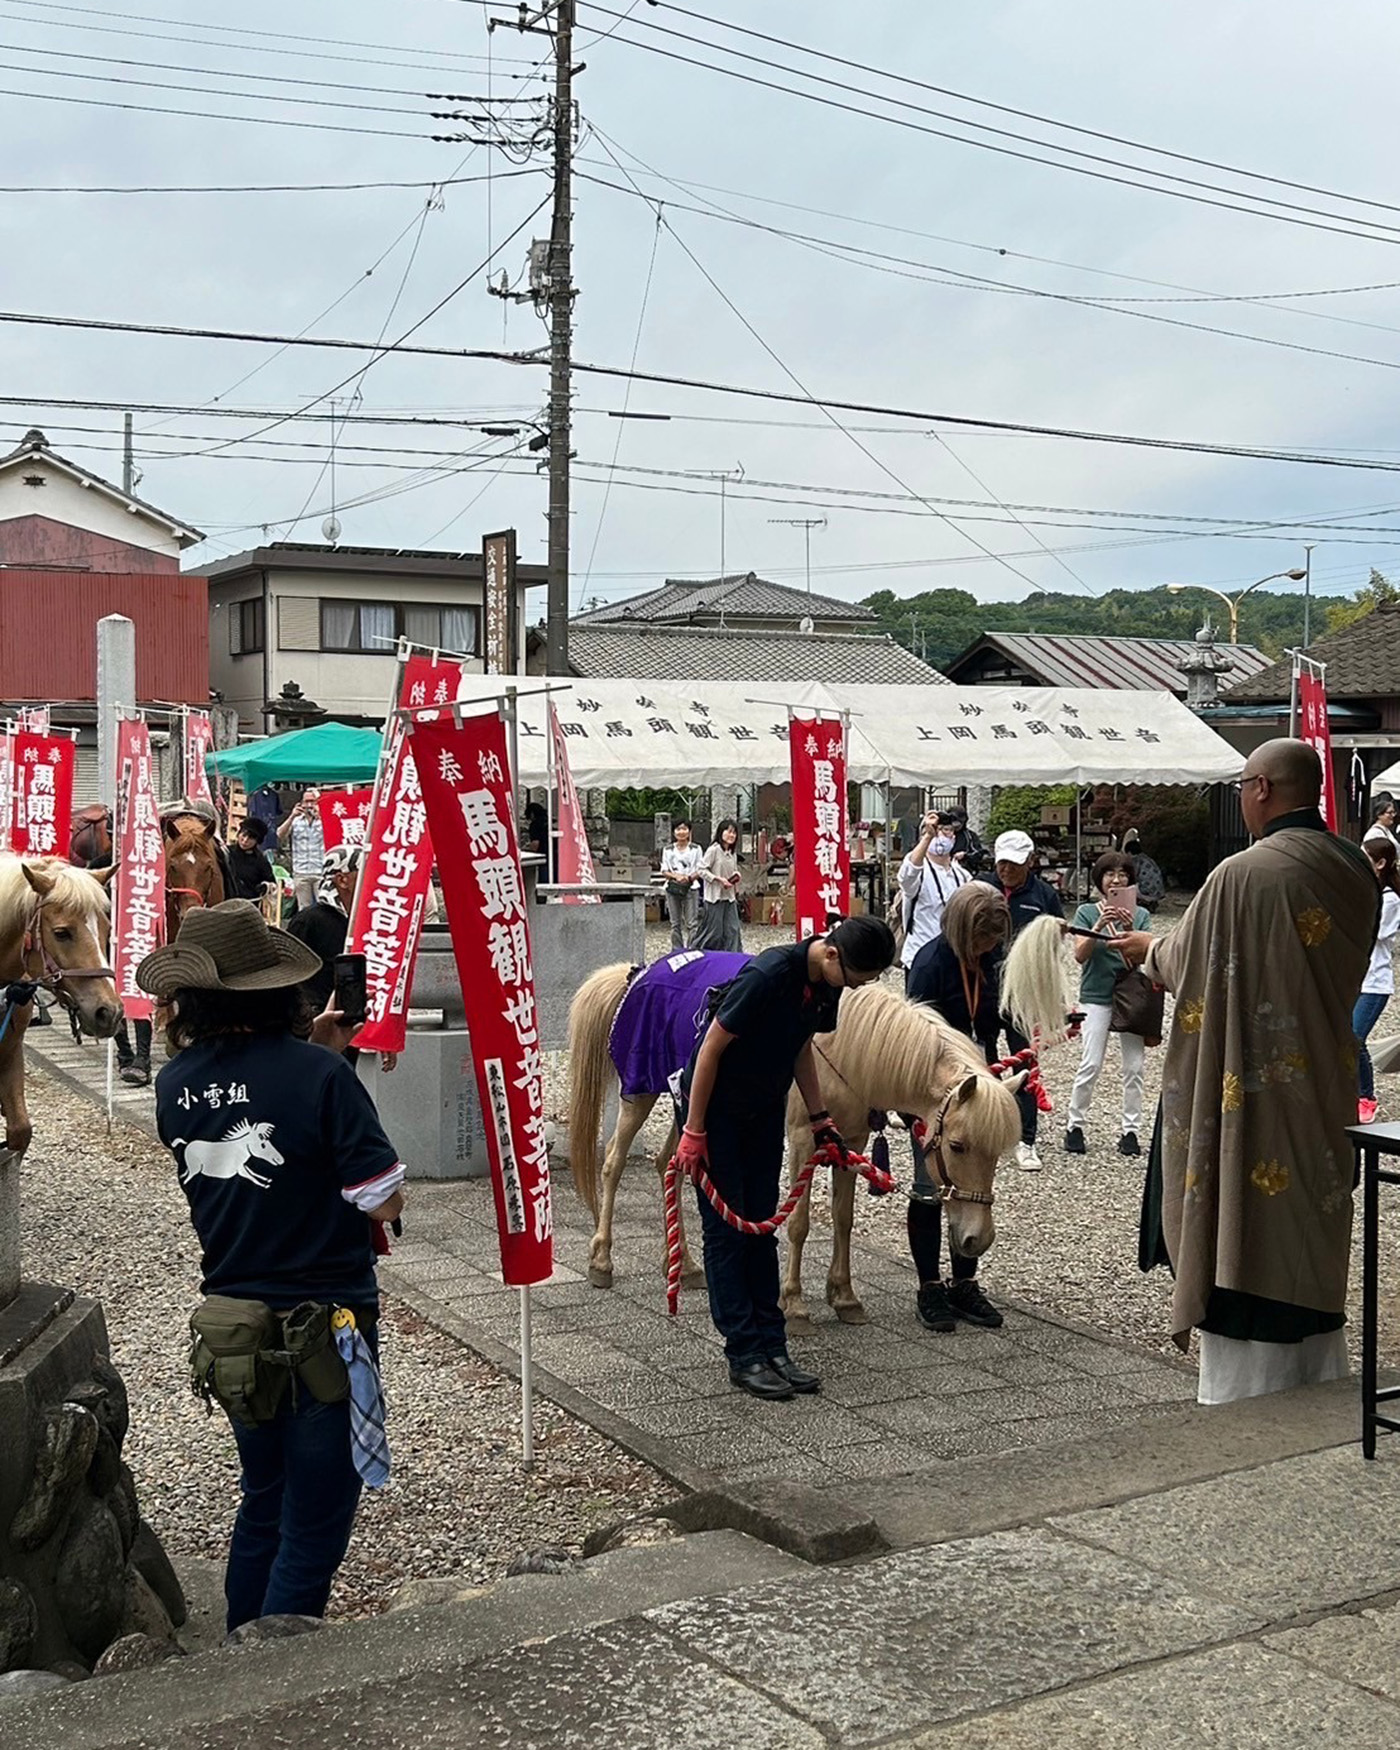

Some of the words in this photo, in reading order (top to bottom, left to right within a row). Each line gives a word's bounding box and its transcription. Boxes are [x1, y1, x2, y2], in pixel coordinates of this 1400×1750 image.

[916, 720, 1161, 743] 上岡馬頭観世音
[804, 733, 843, 760] 奉納
[437, 747, 504, 787] 奉納
[177, 1082, 250, 1110] 小雪組
